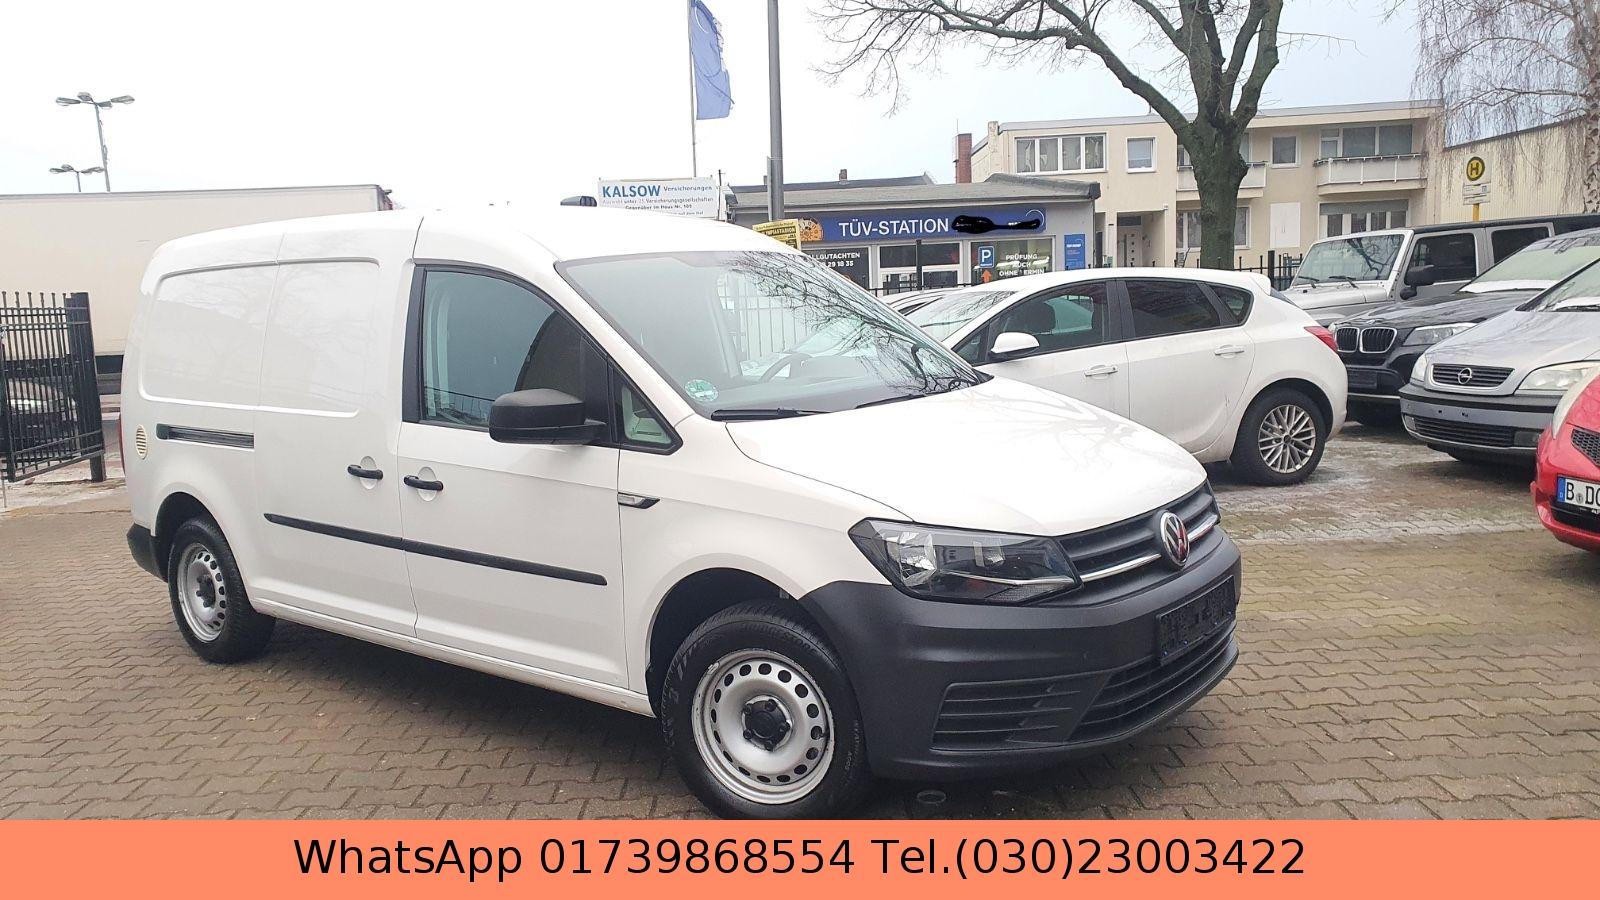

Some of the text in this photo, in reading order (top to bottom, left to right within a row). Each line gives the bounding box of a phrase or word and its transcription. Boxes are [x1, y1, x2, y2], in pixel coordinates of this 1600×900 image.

[1470, 162, 1479, 176] H
[602, 185, 660, 198] KALSOW
[839, 218, 949, 237] TÜV-STATION
[981, 249, 992, 262] P
[998, 269, 1018, 277] OHNE
[1566, 482, 1575, 500] B
